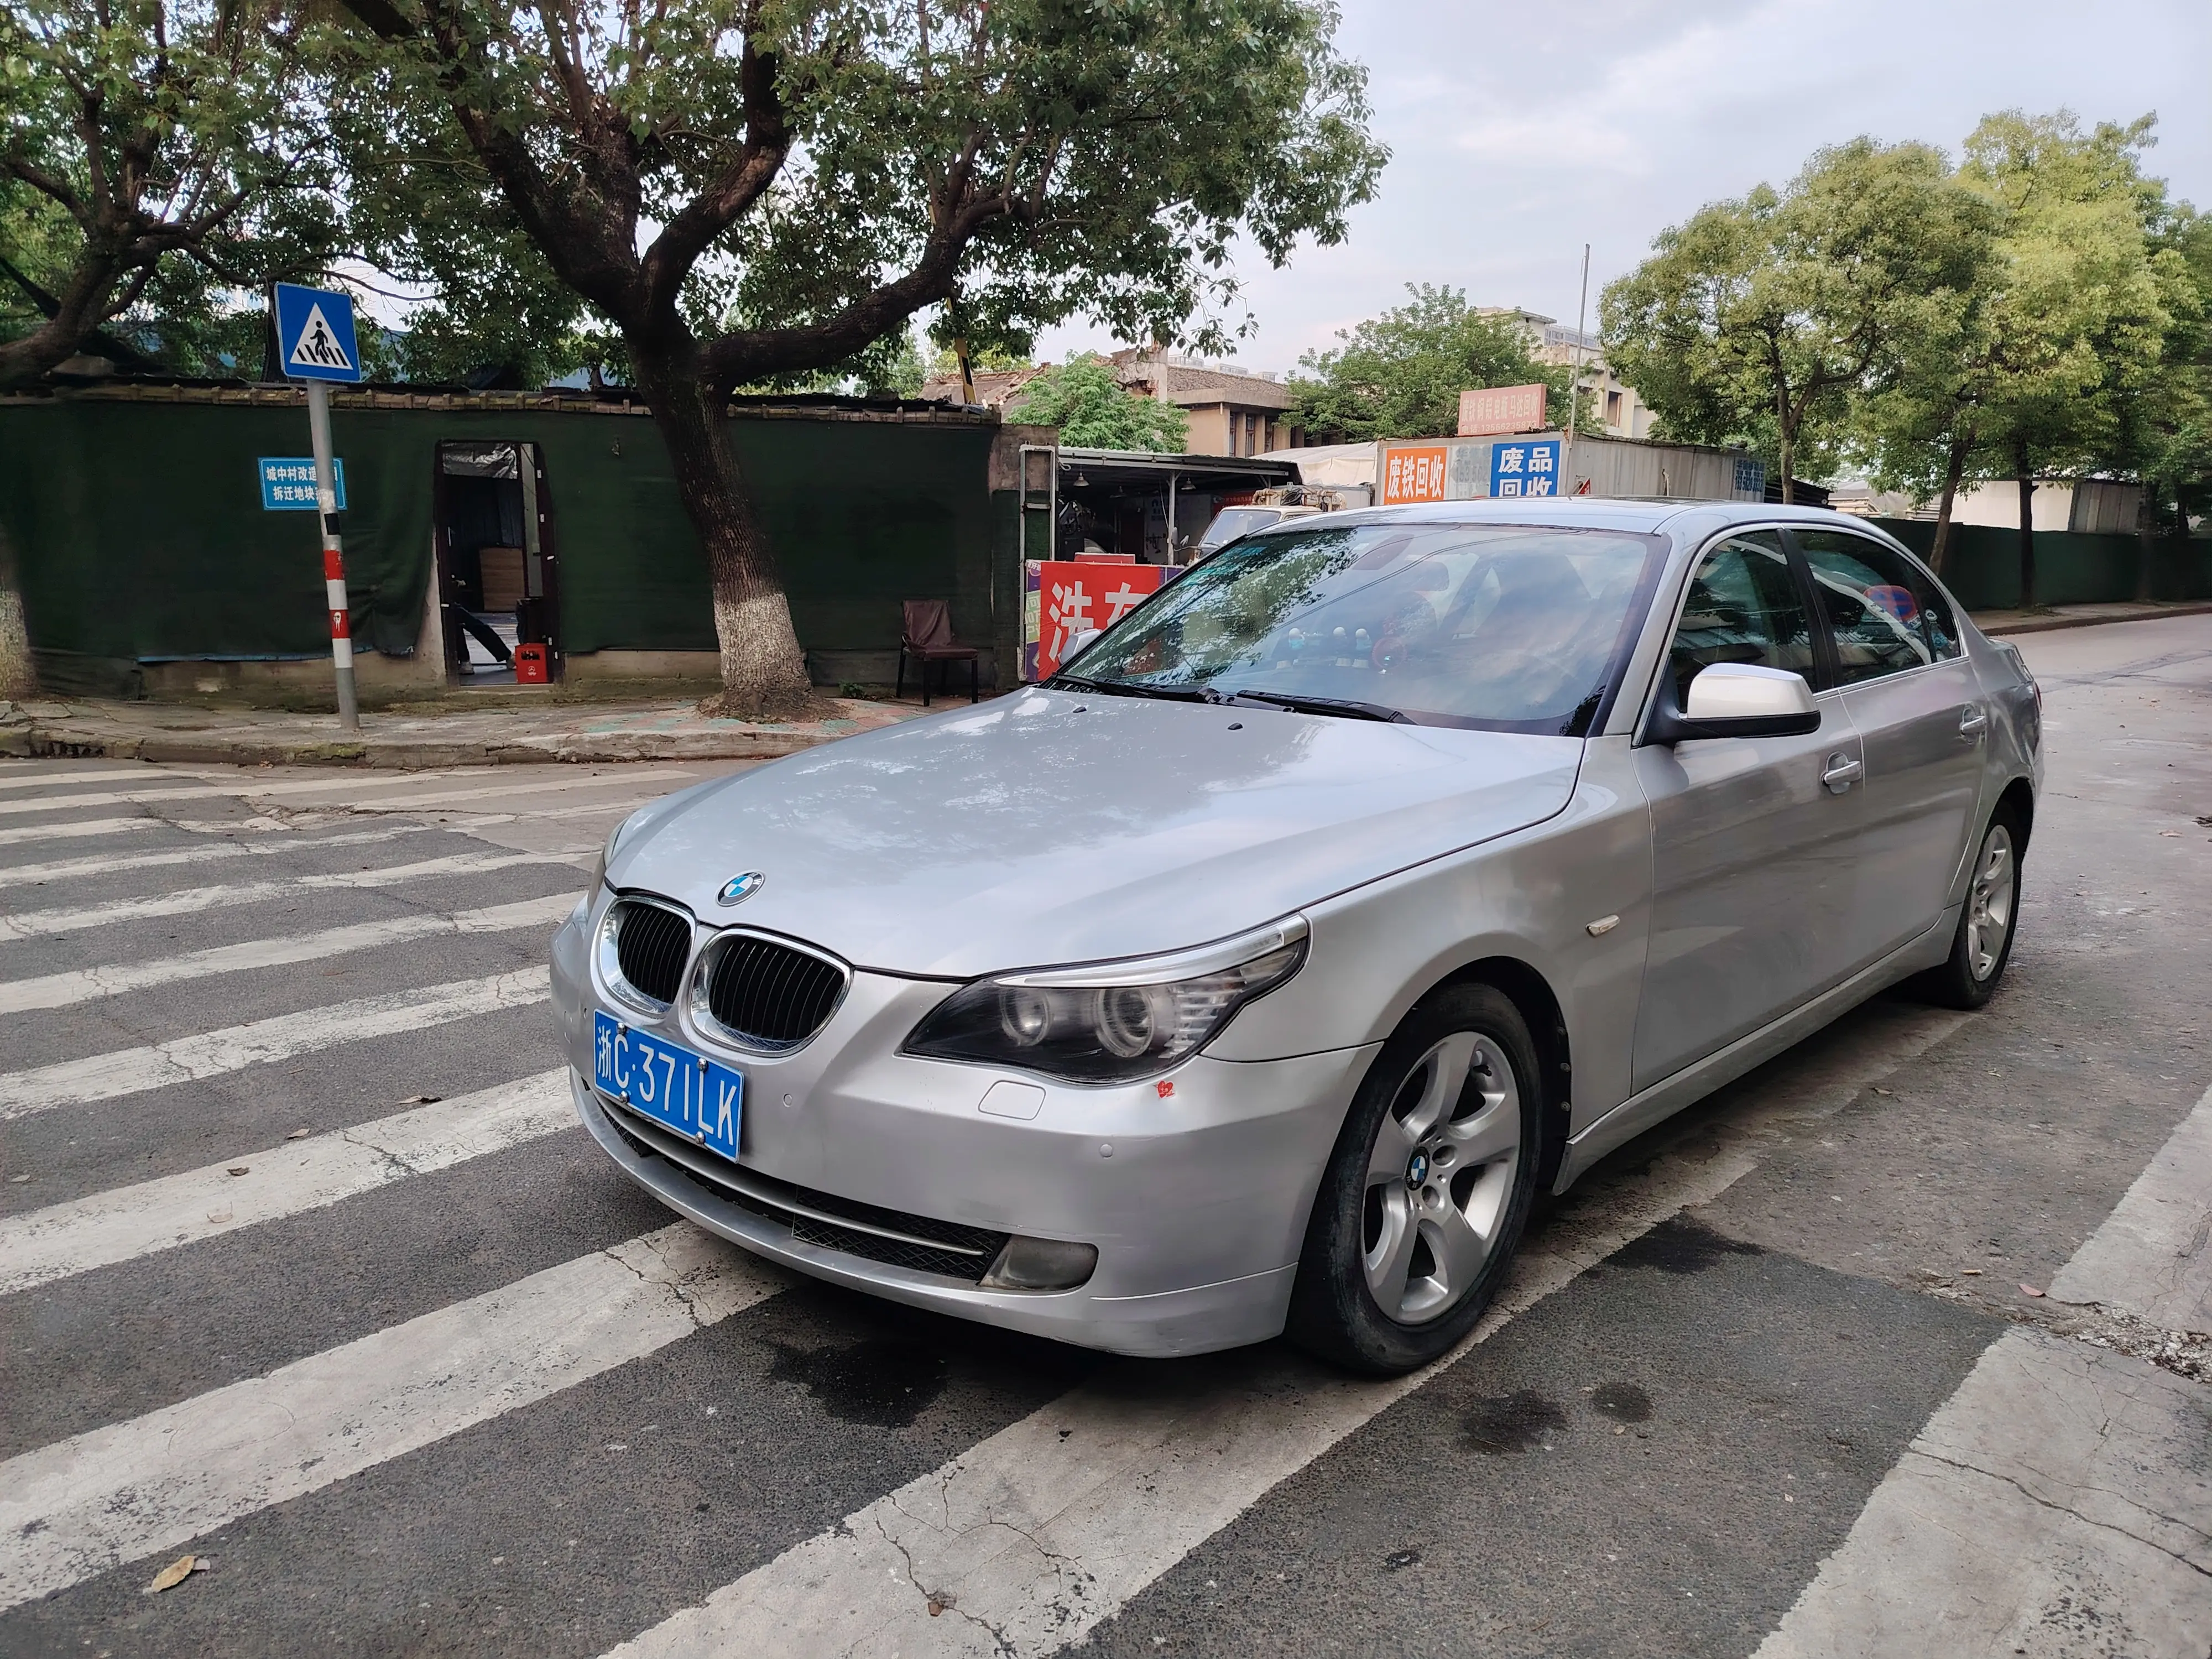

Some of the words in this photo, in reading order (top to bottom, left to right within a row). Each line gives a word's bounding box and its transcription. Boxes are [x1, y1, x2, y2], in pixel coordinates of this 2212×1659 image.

[1498, 447, 1553, 473] 废品
[266, 466, 338, 482] 城中村改造
[1387, 455, 1443, 499] 废铁回收
[273, 486, 320, 501] 拆迁地块
[1499, 476, 1552, 497] 回收
